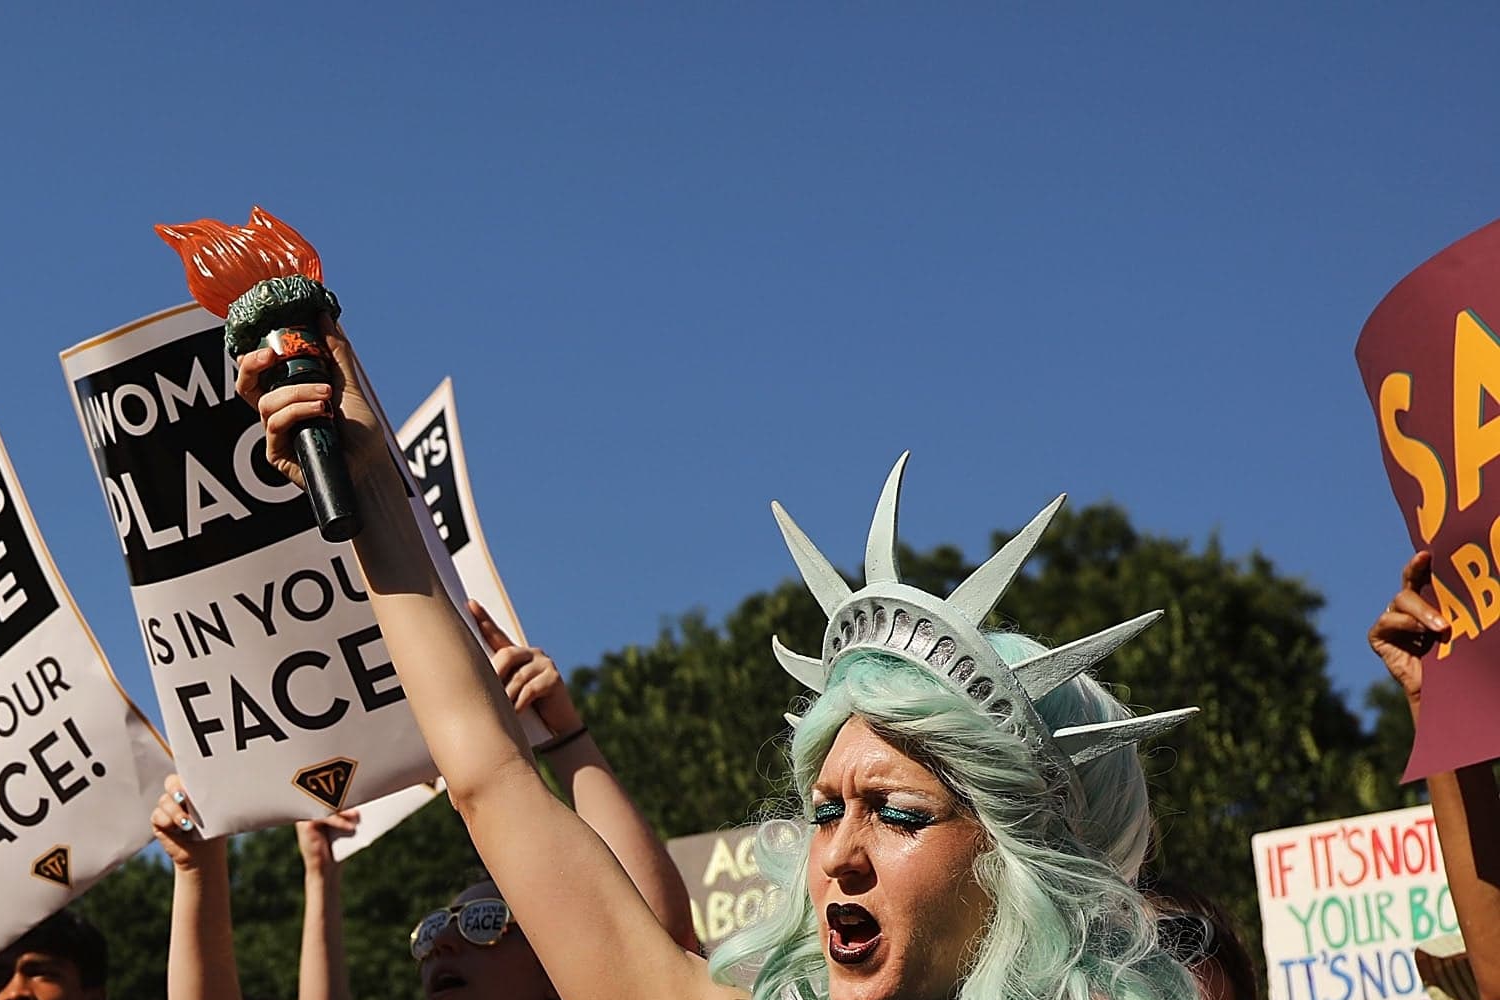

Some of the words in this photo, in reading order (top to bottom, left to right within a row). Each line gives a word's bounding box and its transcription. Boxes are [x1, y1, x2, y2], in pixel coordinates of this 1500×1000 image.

[141, 617, 175, 666] IS
[173, 602, 235, 659] IN
[1267, 843, 1297, 898] IF
[1371, 819, 1438, 880] NOT
[1288, 890, 1401, 954] YOUR
